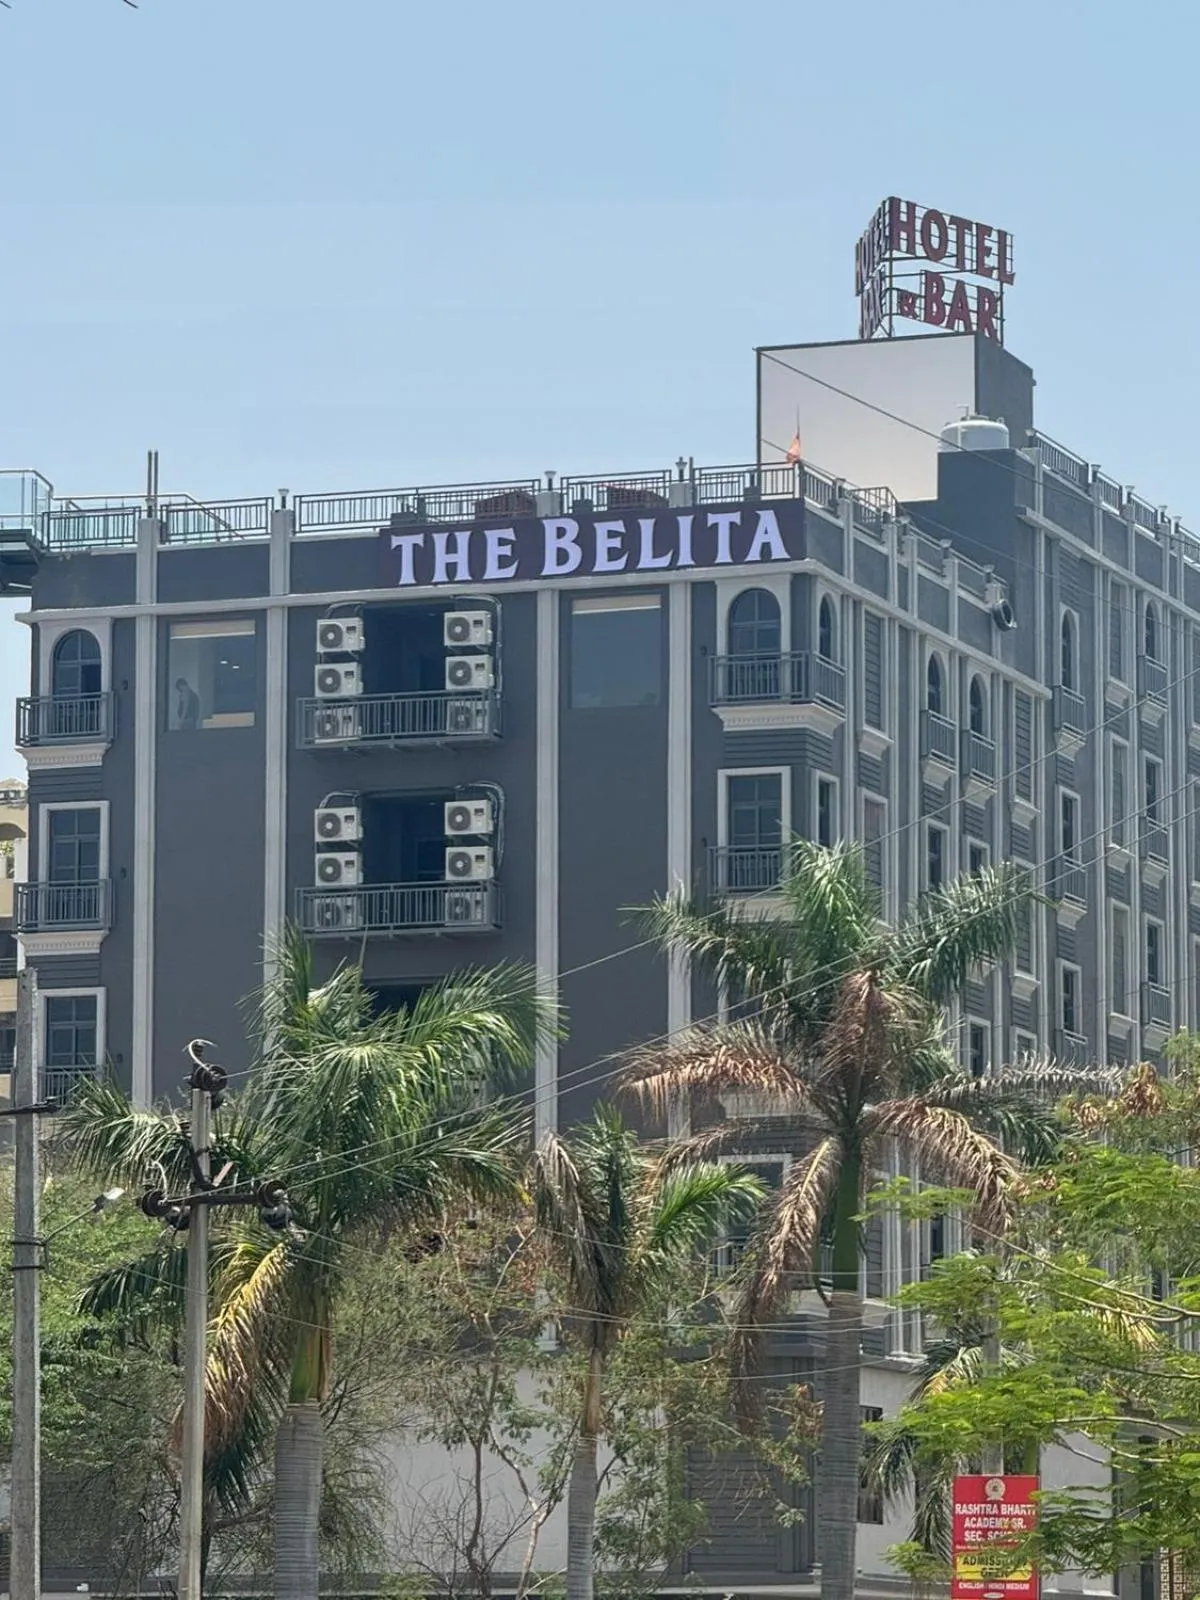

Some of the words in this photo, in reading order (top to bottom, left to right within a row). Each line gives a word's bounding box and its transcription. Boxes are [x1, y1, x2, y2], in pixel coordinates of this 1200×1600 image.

[889, 196, 1015, 286] HOTEL
[924, 270, 1003, 346] BAR
[391, 527, 520, 585] THE
[540, 509, 791, 577] BELITA
[955, 1504, 998, 1515] RASHTRA
[964, 1517, 1009, 1529] ACADEMY
[1011, 1517, 1027, 1529] SR.
[964, 1530, 985, 1542] SEC.
[1006, 1582, 1030, 1591] MEDIUM
